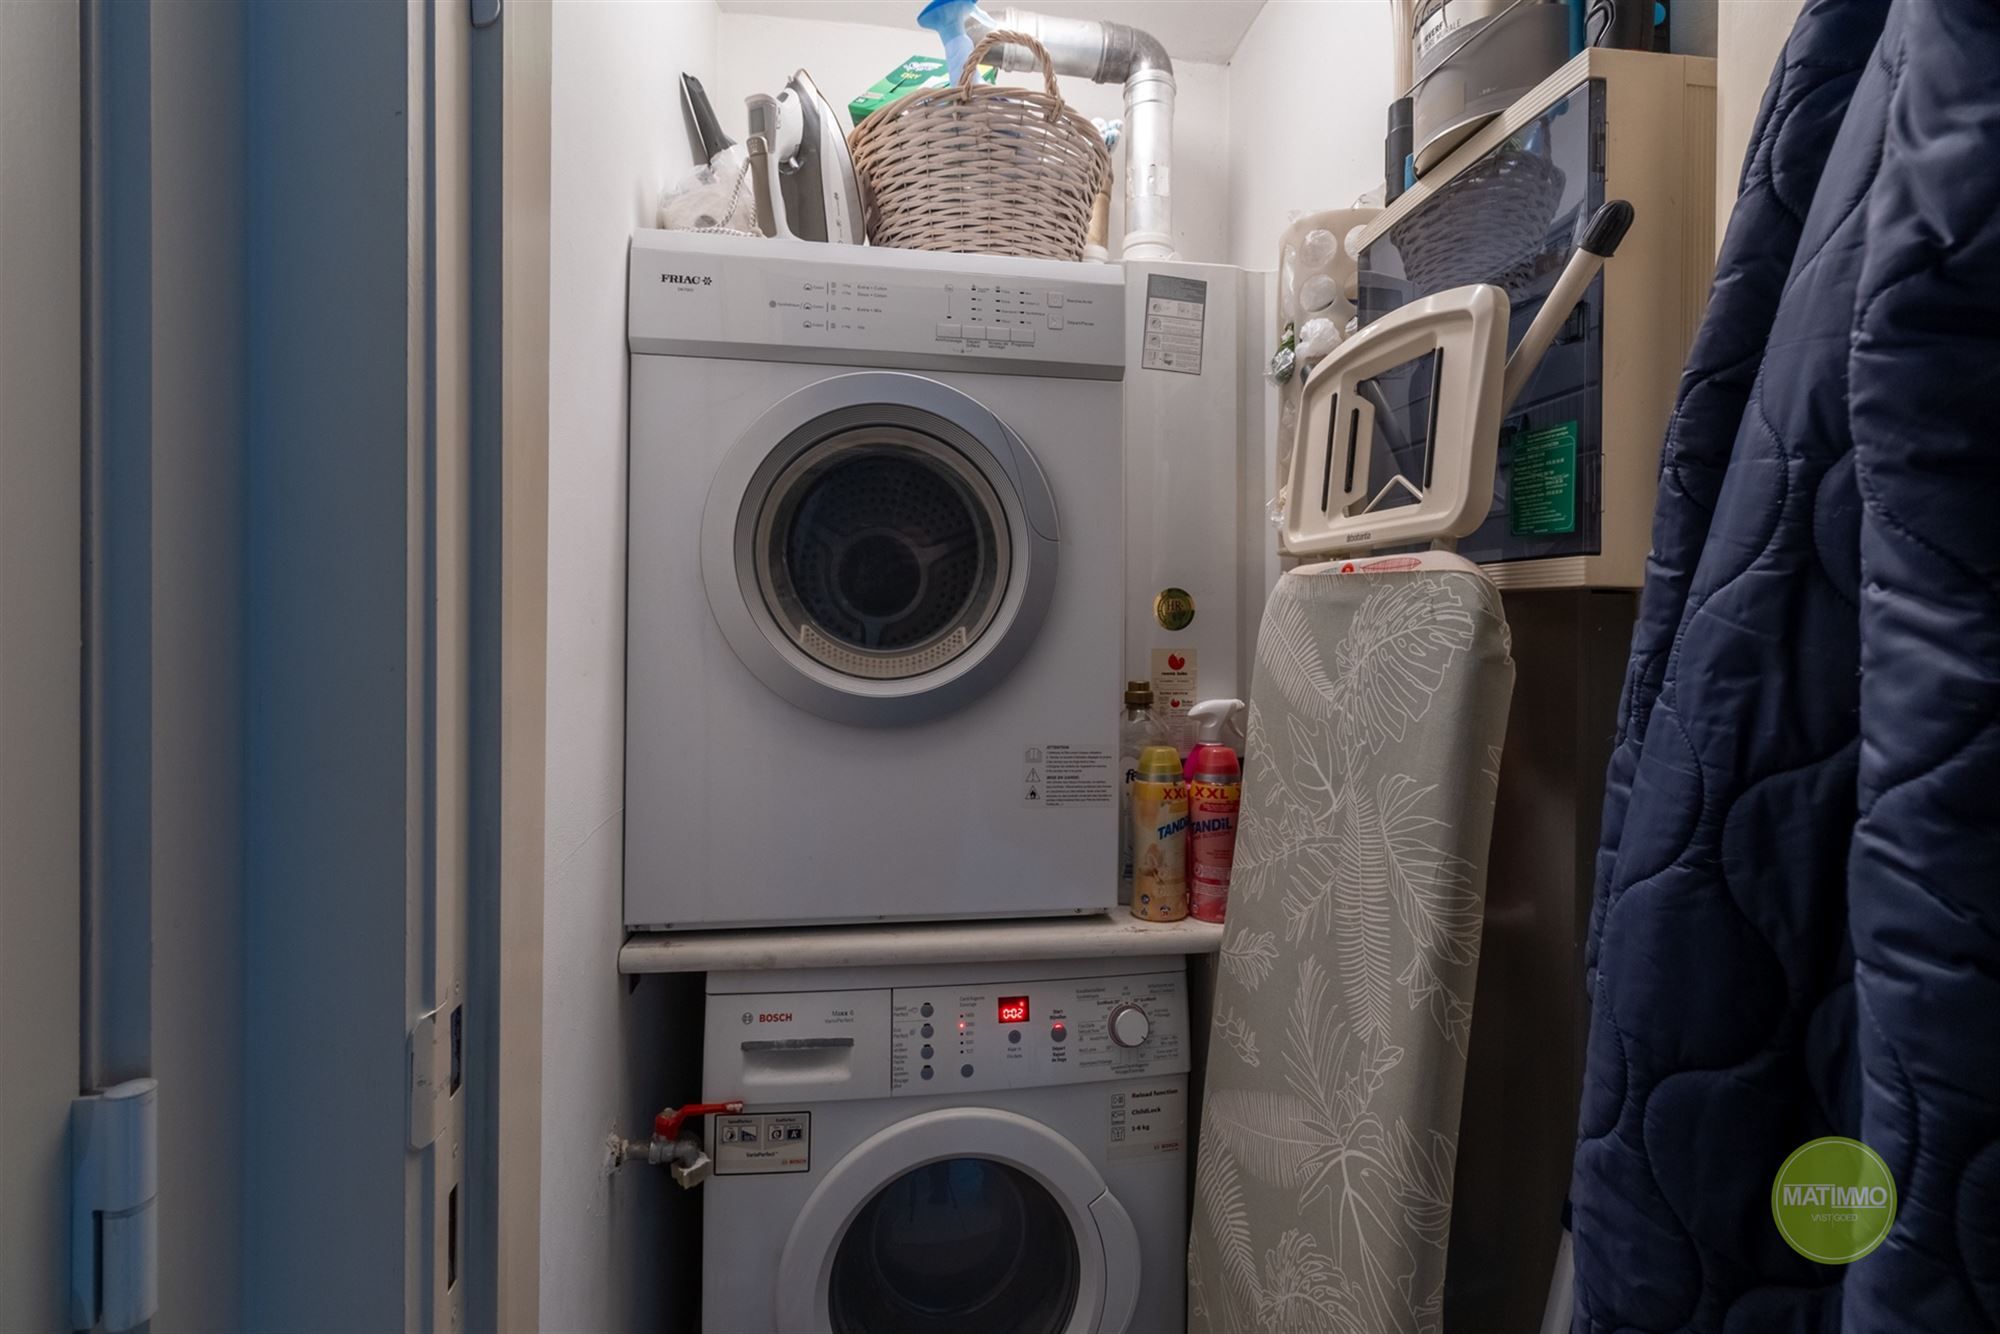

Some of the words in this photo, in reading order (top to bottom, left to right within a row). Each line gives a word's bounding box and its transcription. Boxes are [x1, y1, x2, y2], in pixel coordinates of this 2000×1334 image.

[661, 273, 701, 285] FRIAC
[1195, 786, 1228, 799] XXL
[759, 1013, 792, 1022] BOSCH
[1131, 1107, 1161, 1115] ChildLock
